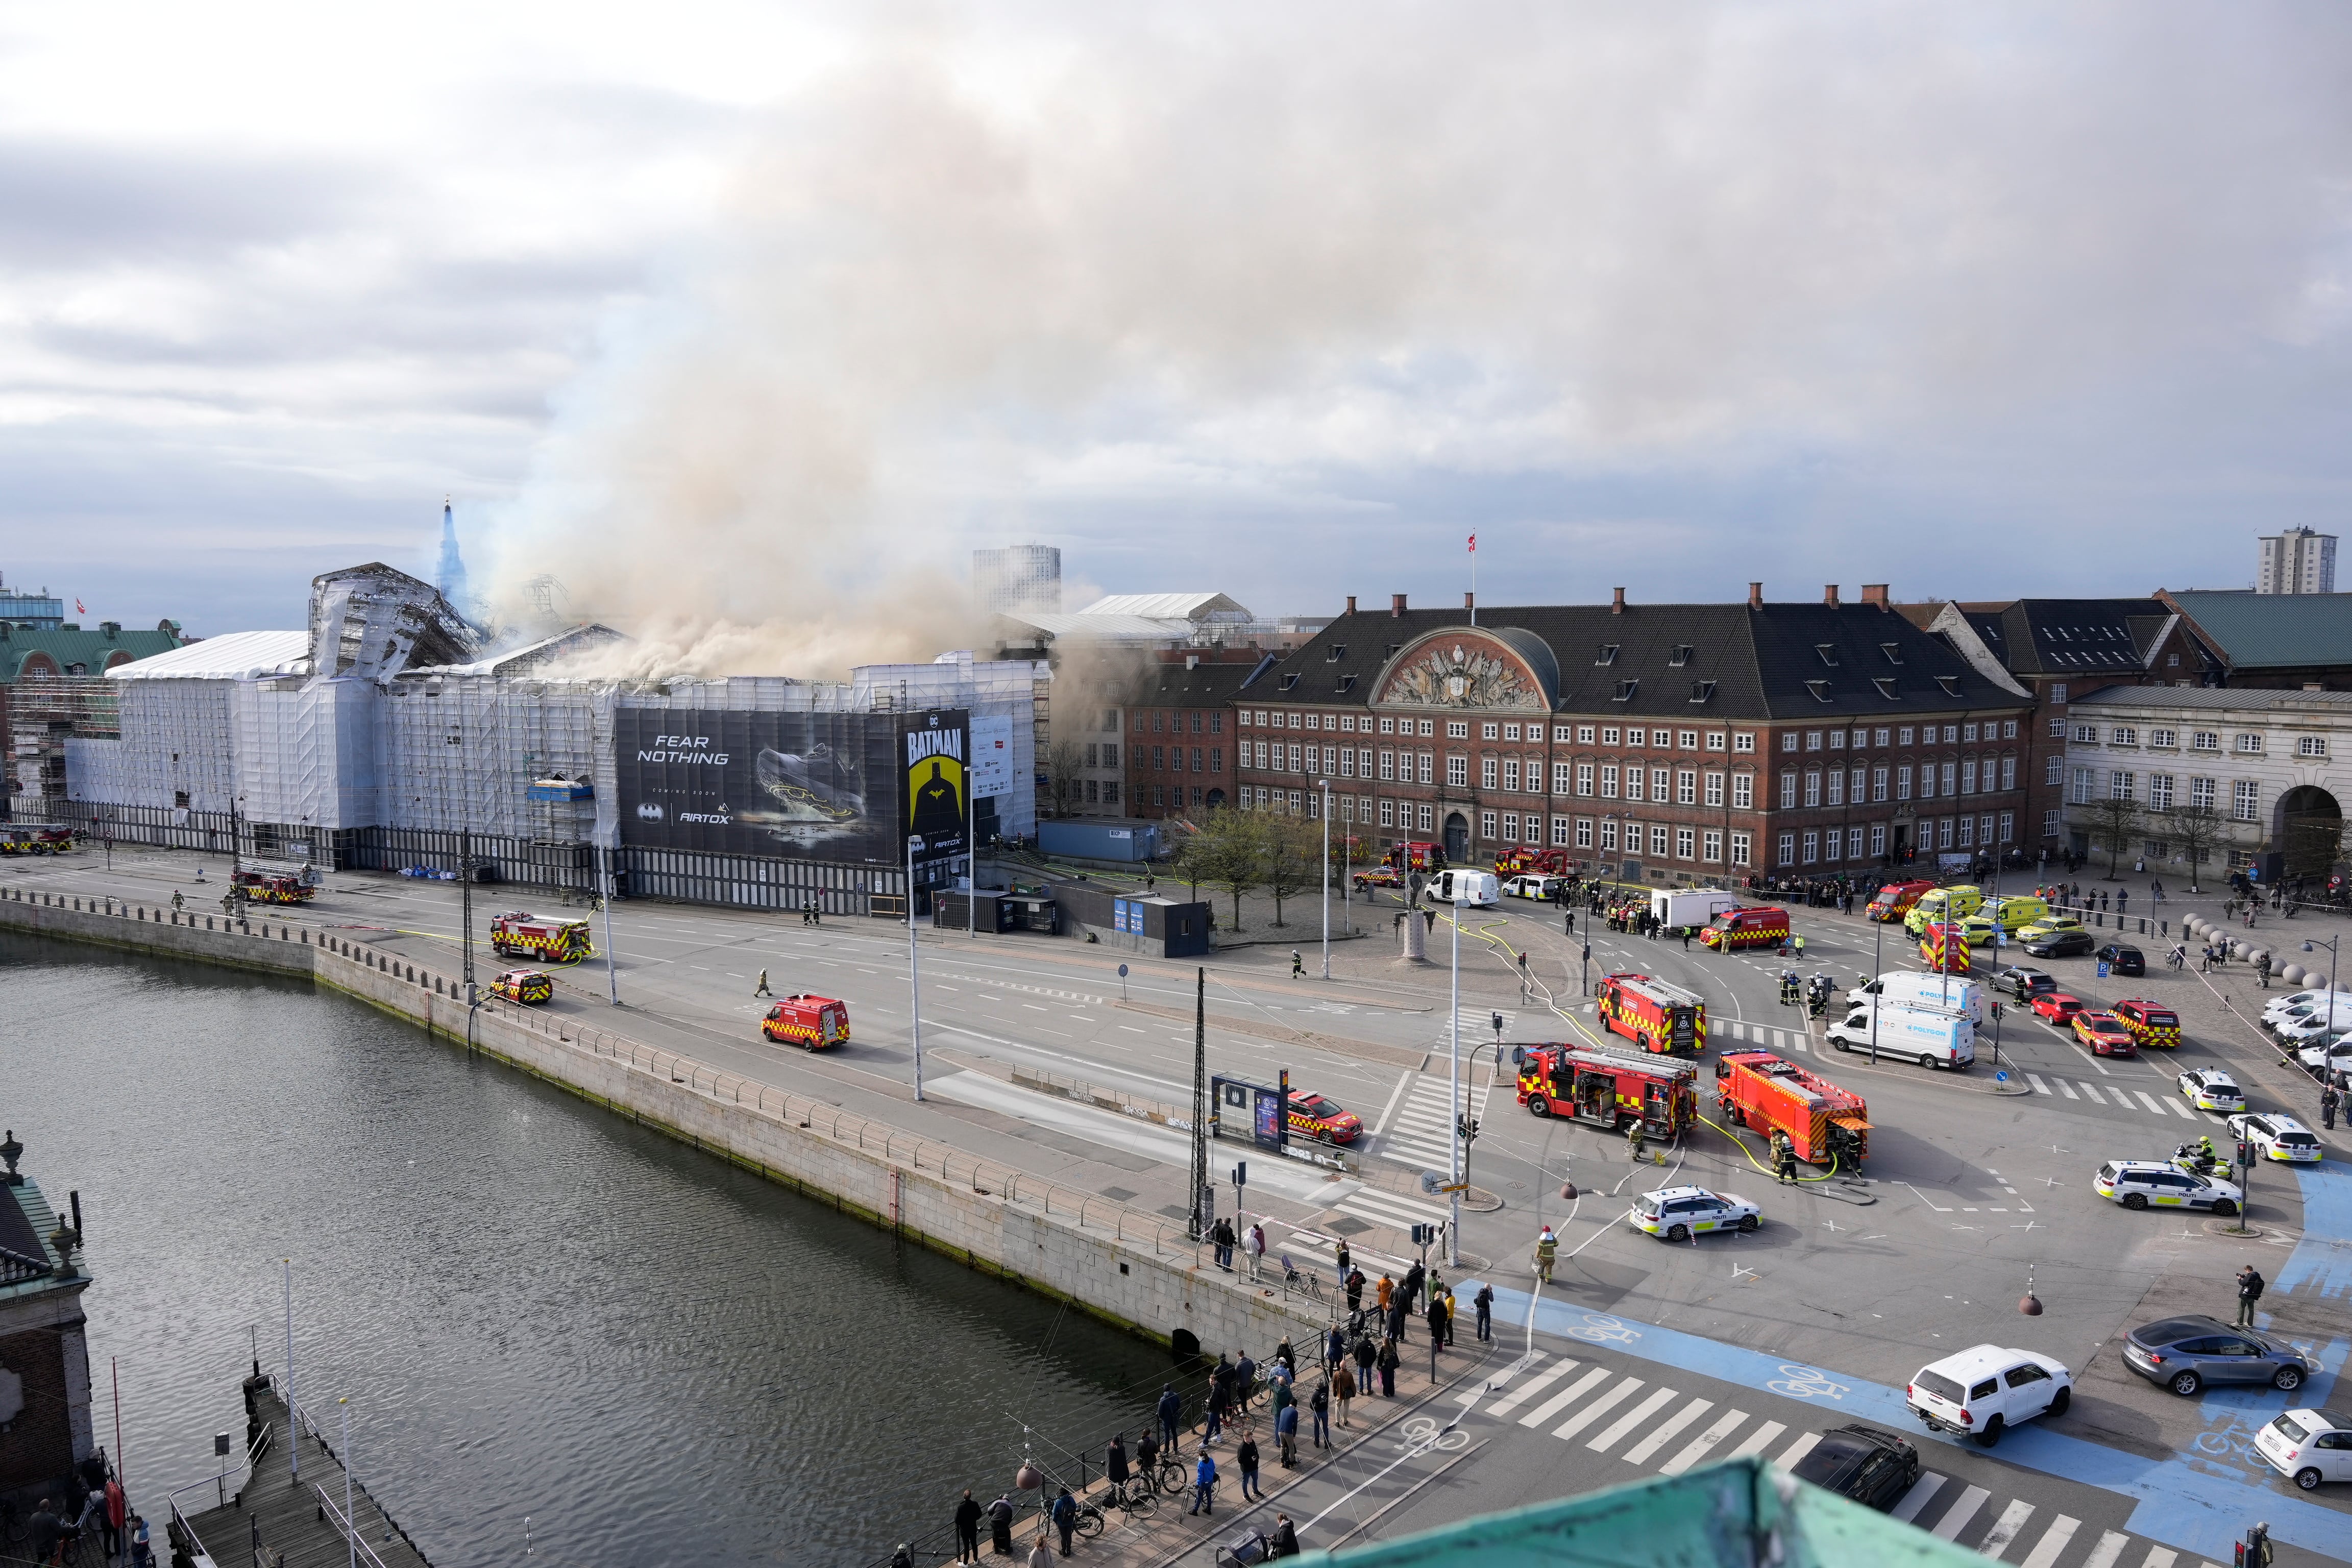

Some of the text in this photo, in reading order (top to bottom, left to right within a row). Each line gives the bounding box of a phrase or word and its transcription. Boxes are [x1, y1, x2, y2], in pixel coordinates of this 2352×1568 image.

[930, 717, 938, 725] DC
[655, 735, 709, 748] FEAR
[908, 728, 962, 767] BATMAN
[638, 750, 729, 765] NOTHING
[679, 813, 730, 824] AIRTOX
[935, 839, 961, 848] AIRTOX
[1925, 991, 1957, 1001] POLYON
[1913, 1025, 1946, 1037] POLYGON
[1913, 1033, 1946, 1041] SKADESERVICE
[1288, 1123, 1314, 1134] INDSATSLEDER
